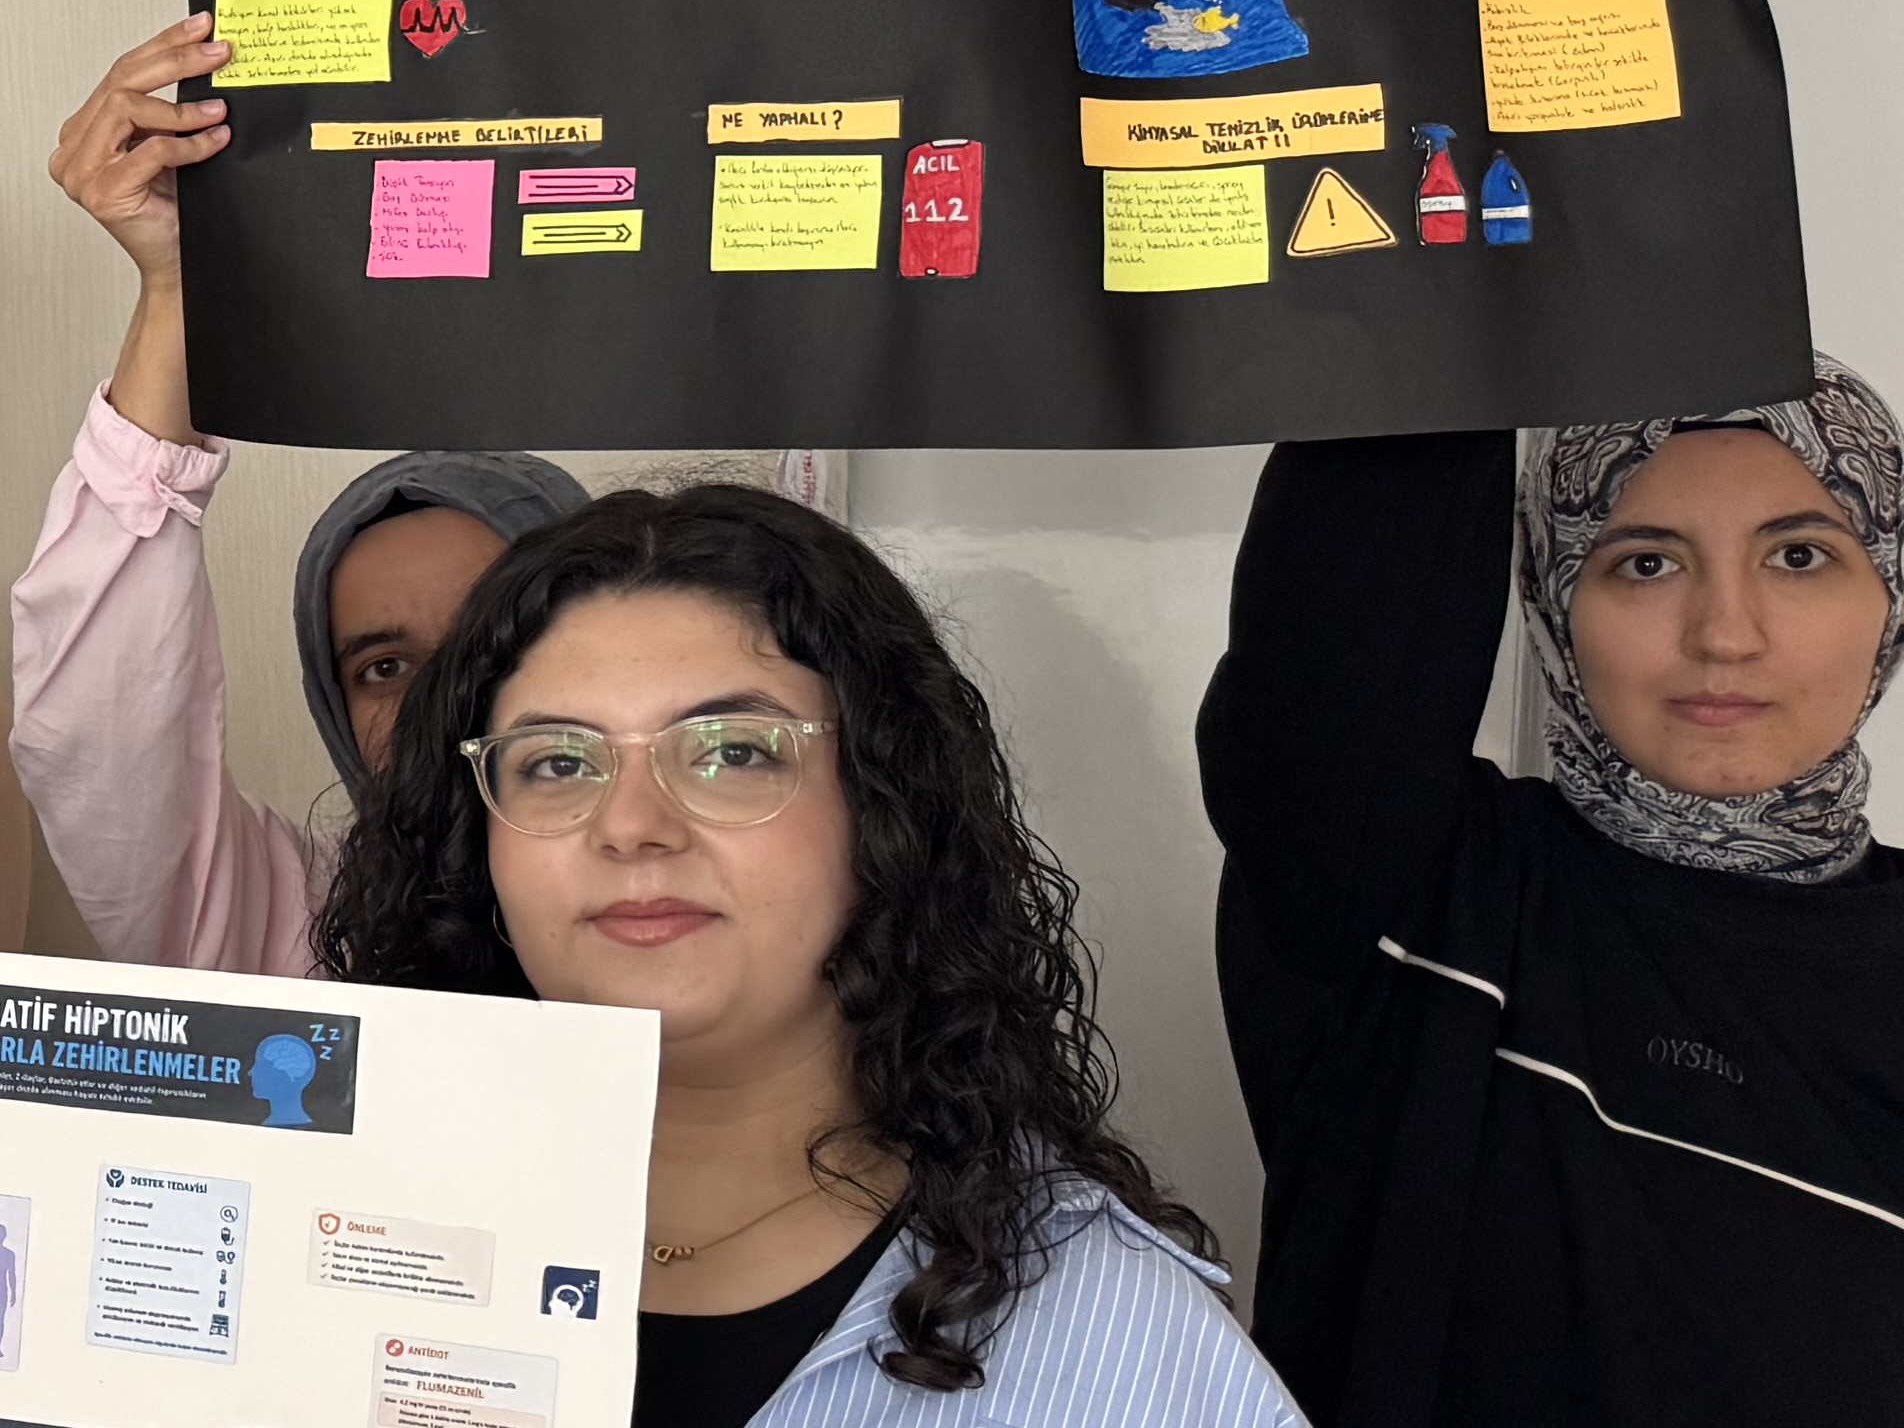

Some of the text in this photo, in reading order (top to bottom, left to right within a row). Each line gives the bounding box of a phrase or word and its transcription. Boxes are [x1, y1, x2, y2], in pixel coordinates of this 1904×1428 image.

[722, 113, 742, 128] NE
[1128, 123, 1199, 141] KİMYASAL
[352, 129, 460, 146] ZEHİRLENME
[904, 197, 969, 223] 112
[64, 1000, 189, 1044] HİPTONİK
[53, 1040, 241, 1084] ZEHİRLENMELER
[1646, 1034, 1745, 1085] OYSHO
